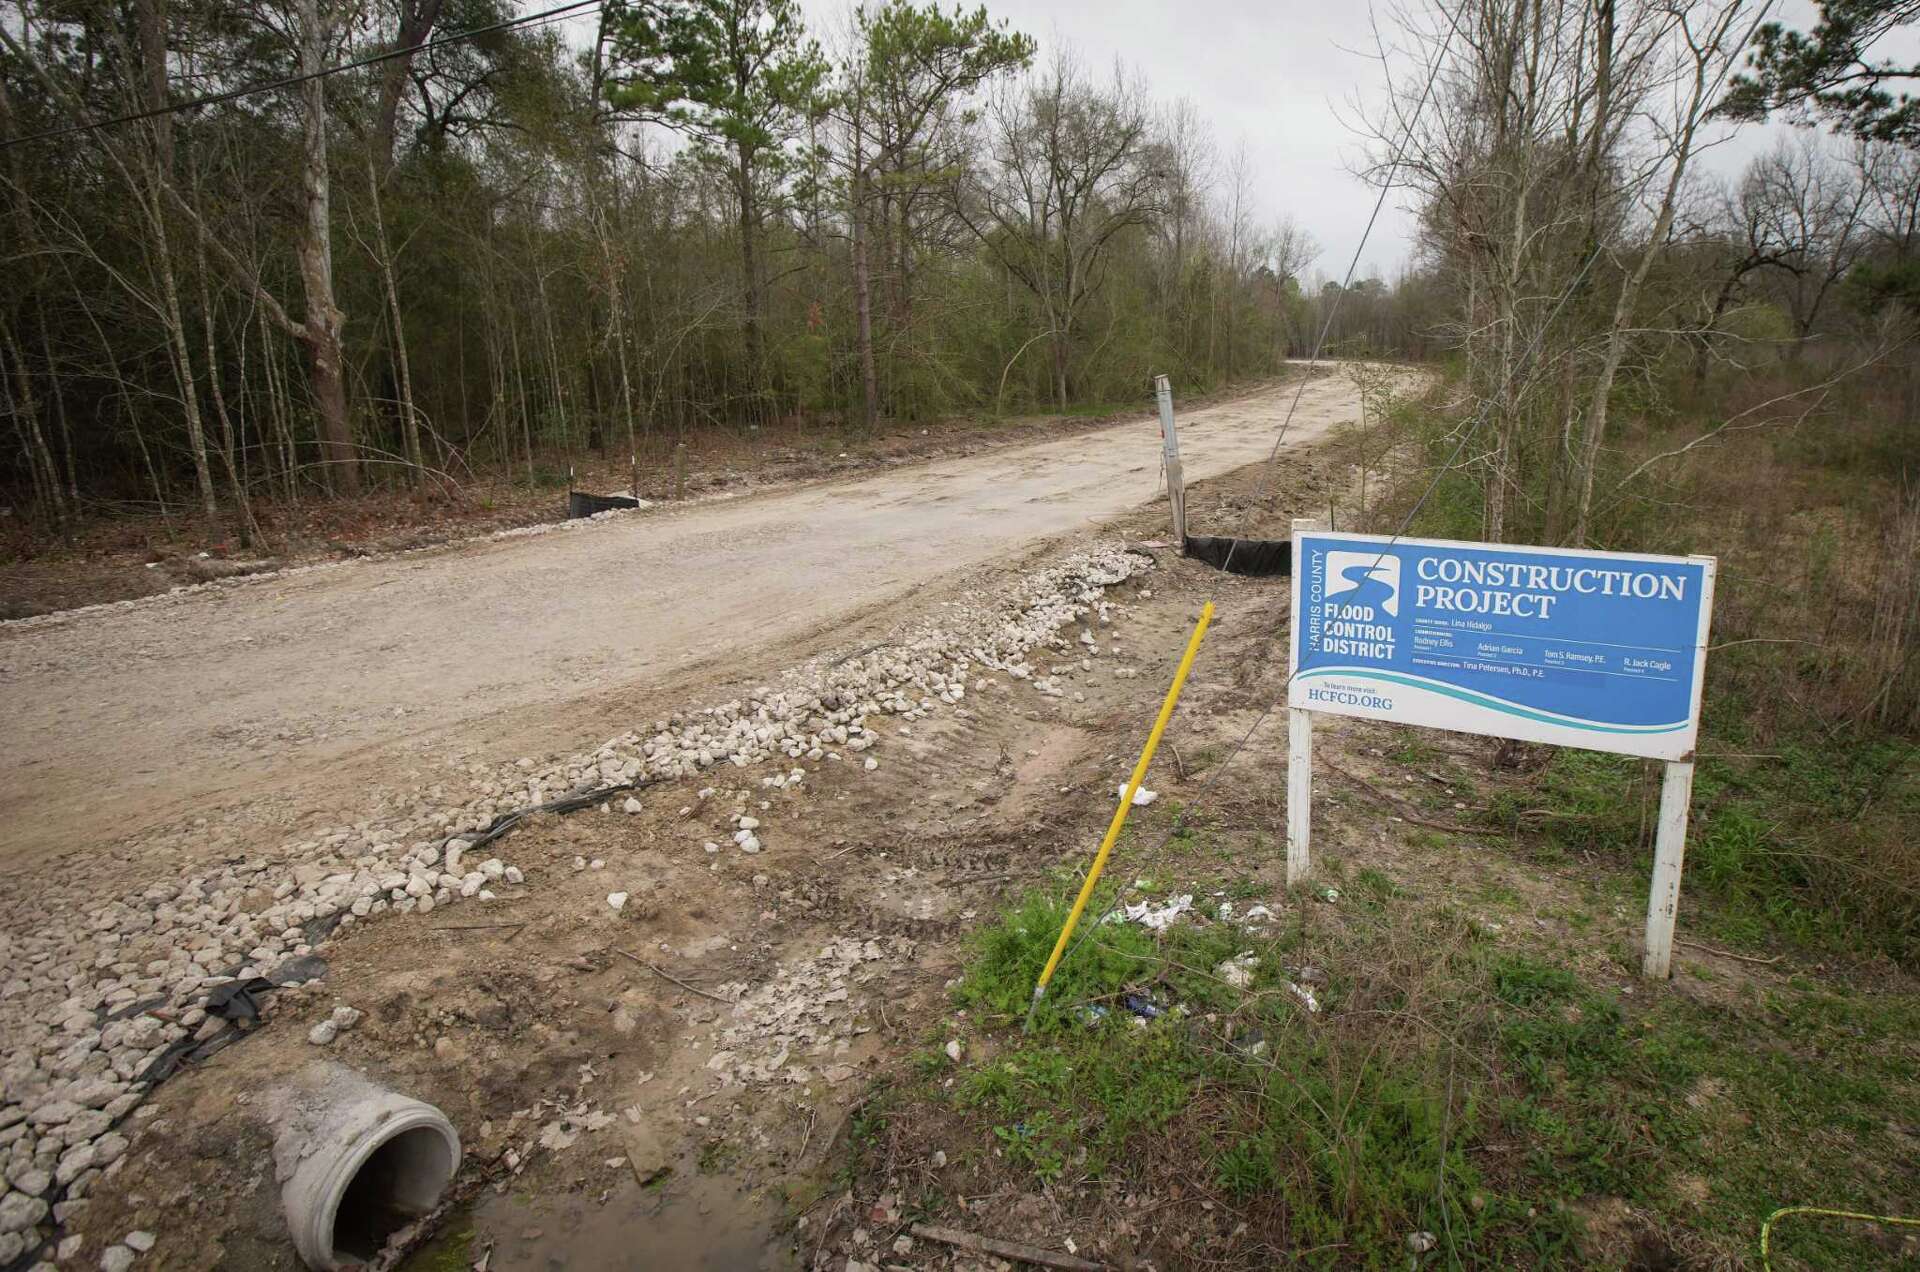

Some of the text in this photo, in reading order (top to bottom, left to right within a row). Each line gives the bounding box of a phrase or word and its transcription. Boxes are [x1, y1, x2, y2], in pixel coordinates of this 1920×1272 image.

[1417, 557, 1687, 601] CONSTRUCTION
[1309, 549, 1323, 651] HARRIS COUNTY
[1416, 585, 1556, 619] PROJECT
[1324, 603, 1374, 622] FLOOD
[1324, 620, 1395, 642] CONTROL
[1451, 618, 1465, 627] Lina
[1467, 620, 1492, 631] Hidalgo
[1323, 638, 1395, 660] DISTRICT
[1414, 636, 1438, 647] Rodney
[1478, 642, 1500, 653] Adrian
[1501, 645, 1523, 655] Garcia
[1544, 649, 1558, 659] Tom
[1463, 661, 1478, 670] Tina
[1633, 658, 1648, 668] Jack
[1650, 660, 1672, 671] Cagle
[1308, 688, 1393, 710] HCFCD.ORG
